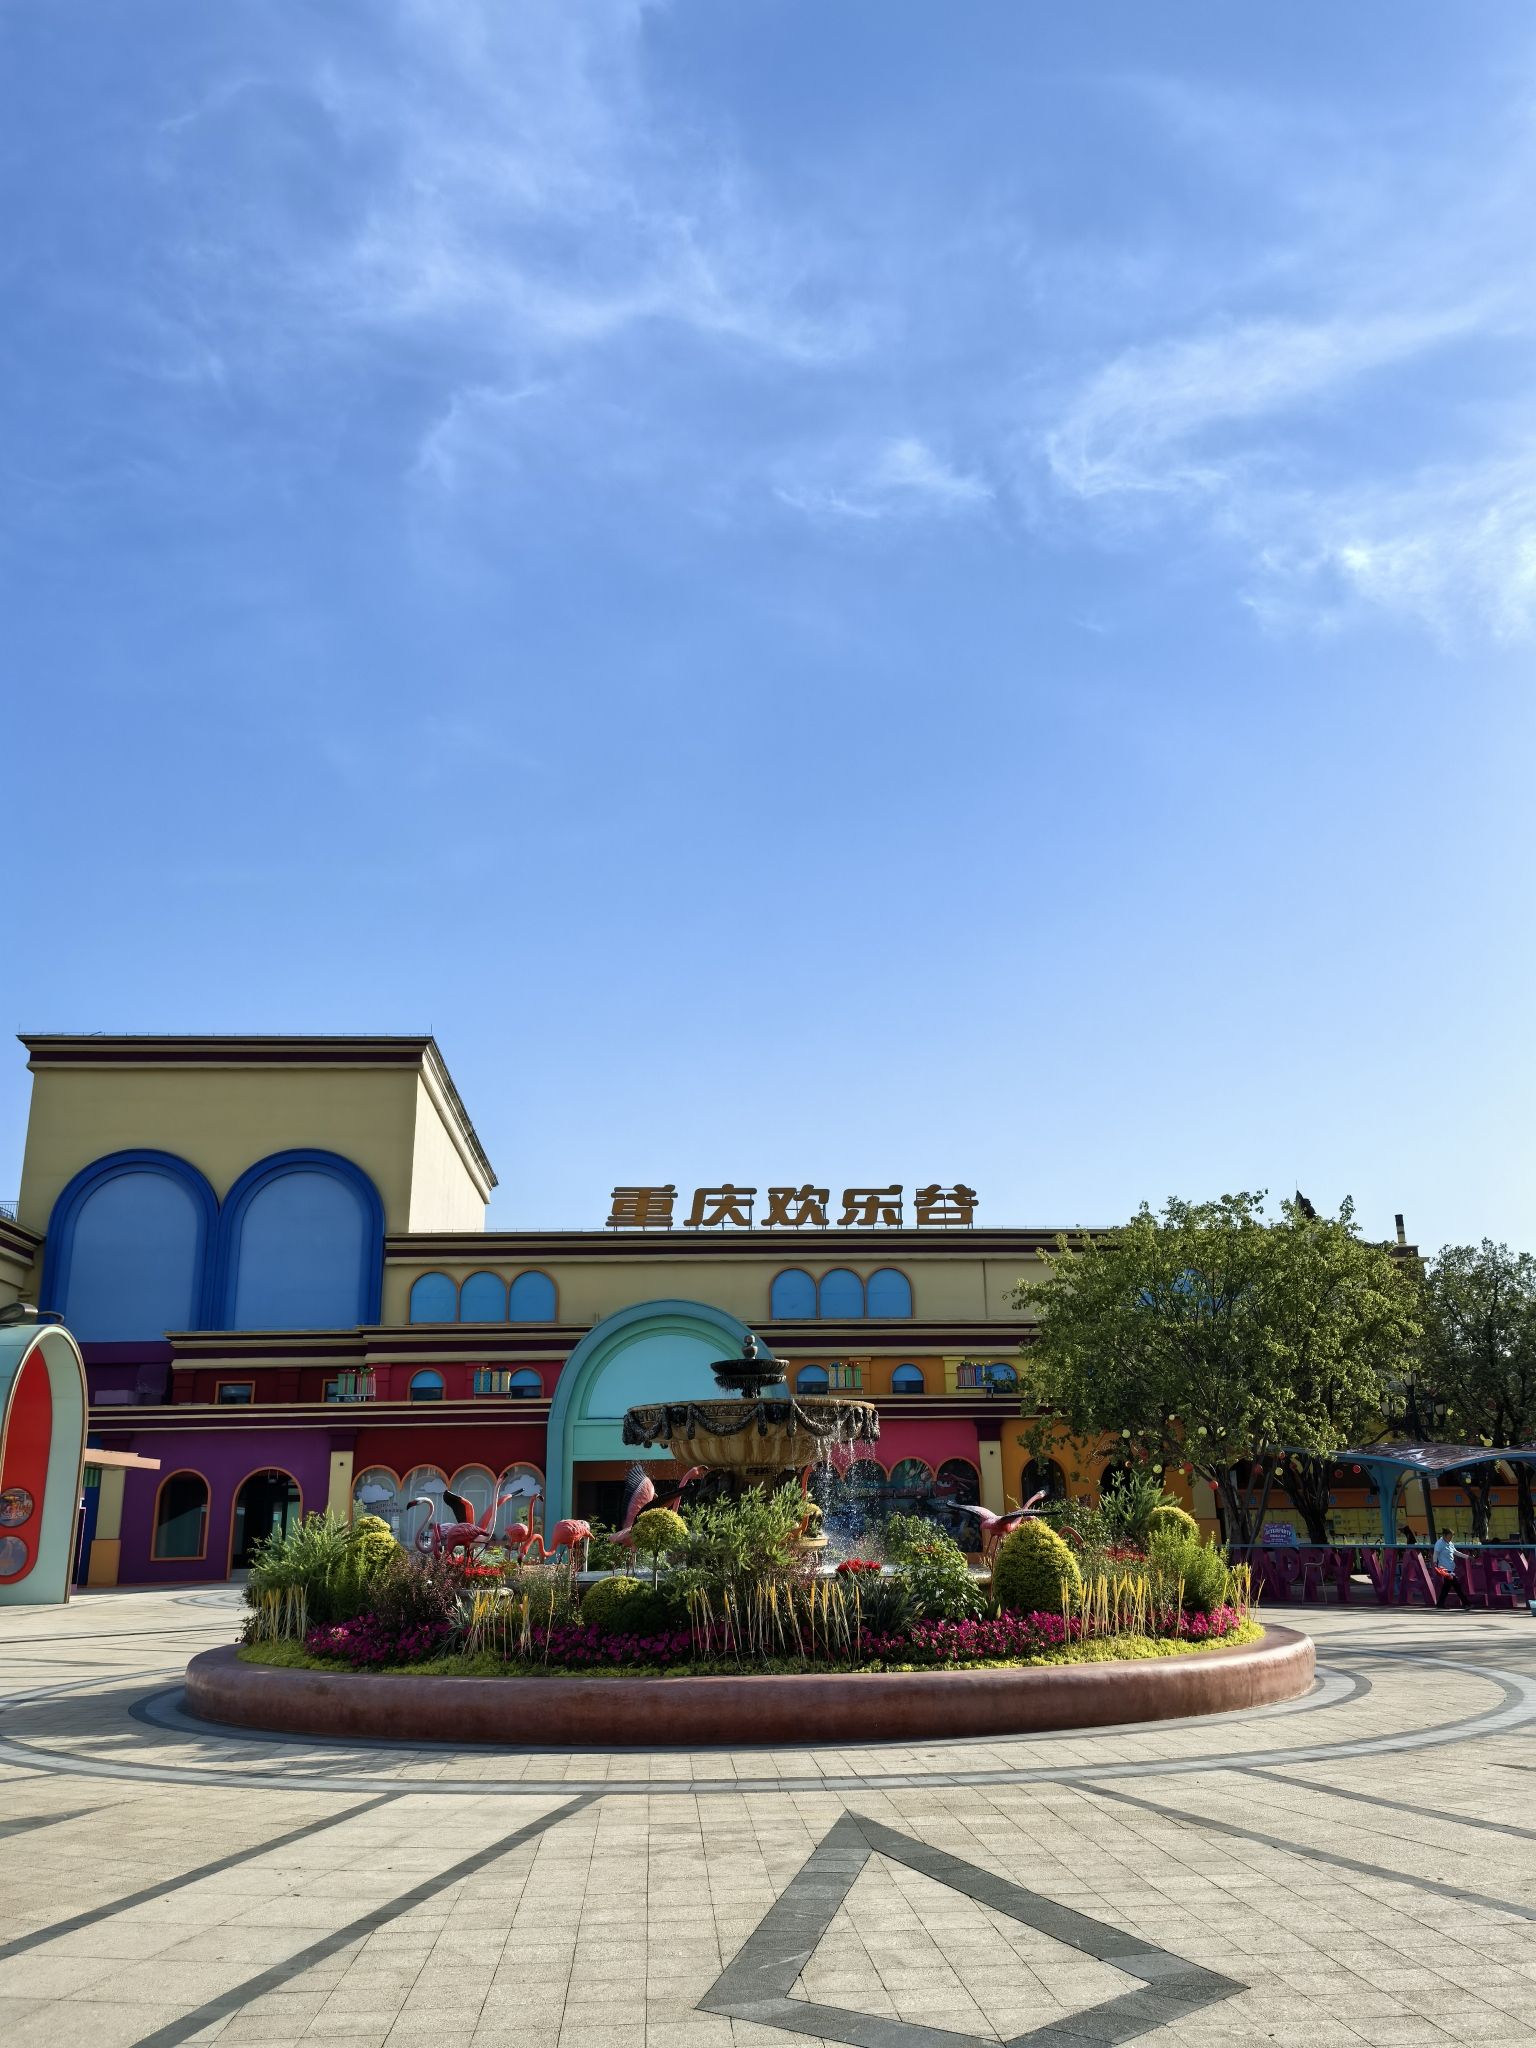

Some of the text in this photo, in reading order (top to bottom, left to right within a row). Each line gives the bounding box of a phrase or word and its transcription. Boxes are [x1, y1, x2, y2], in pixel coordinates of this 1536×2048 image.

[605, 1184, 979, 1227] 重庆欢乐谷
